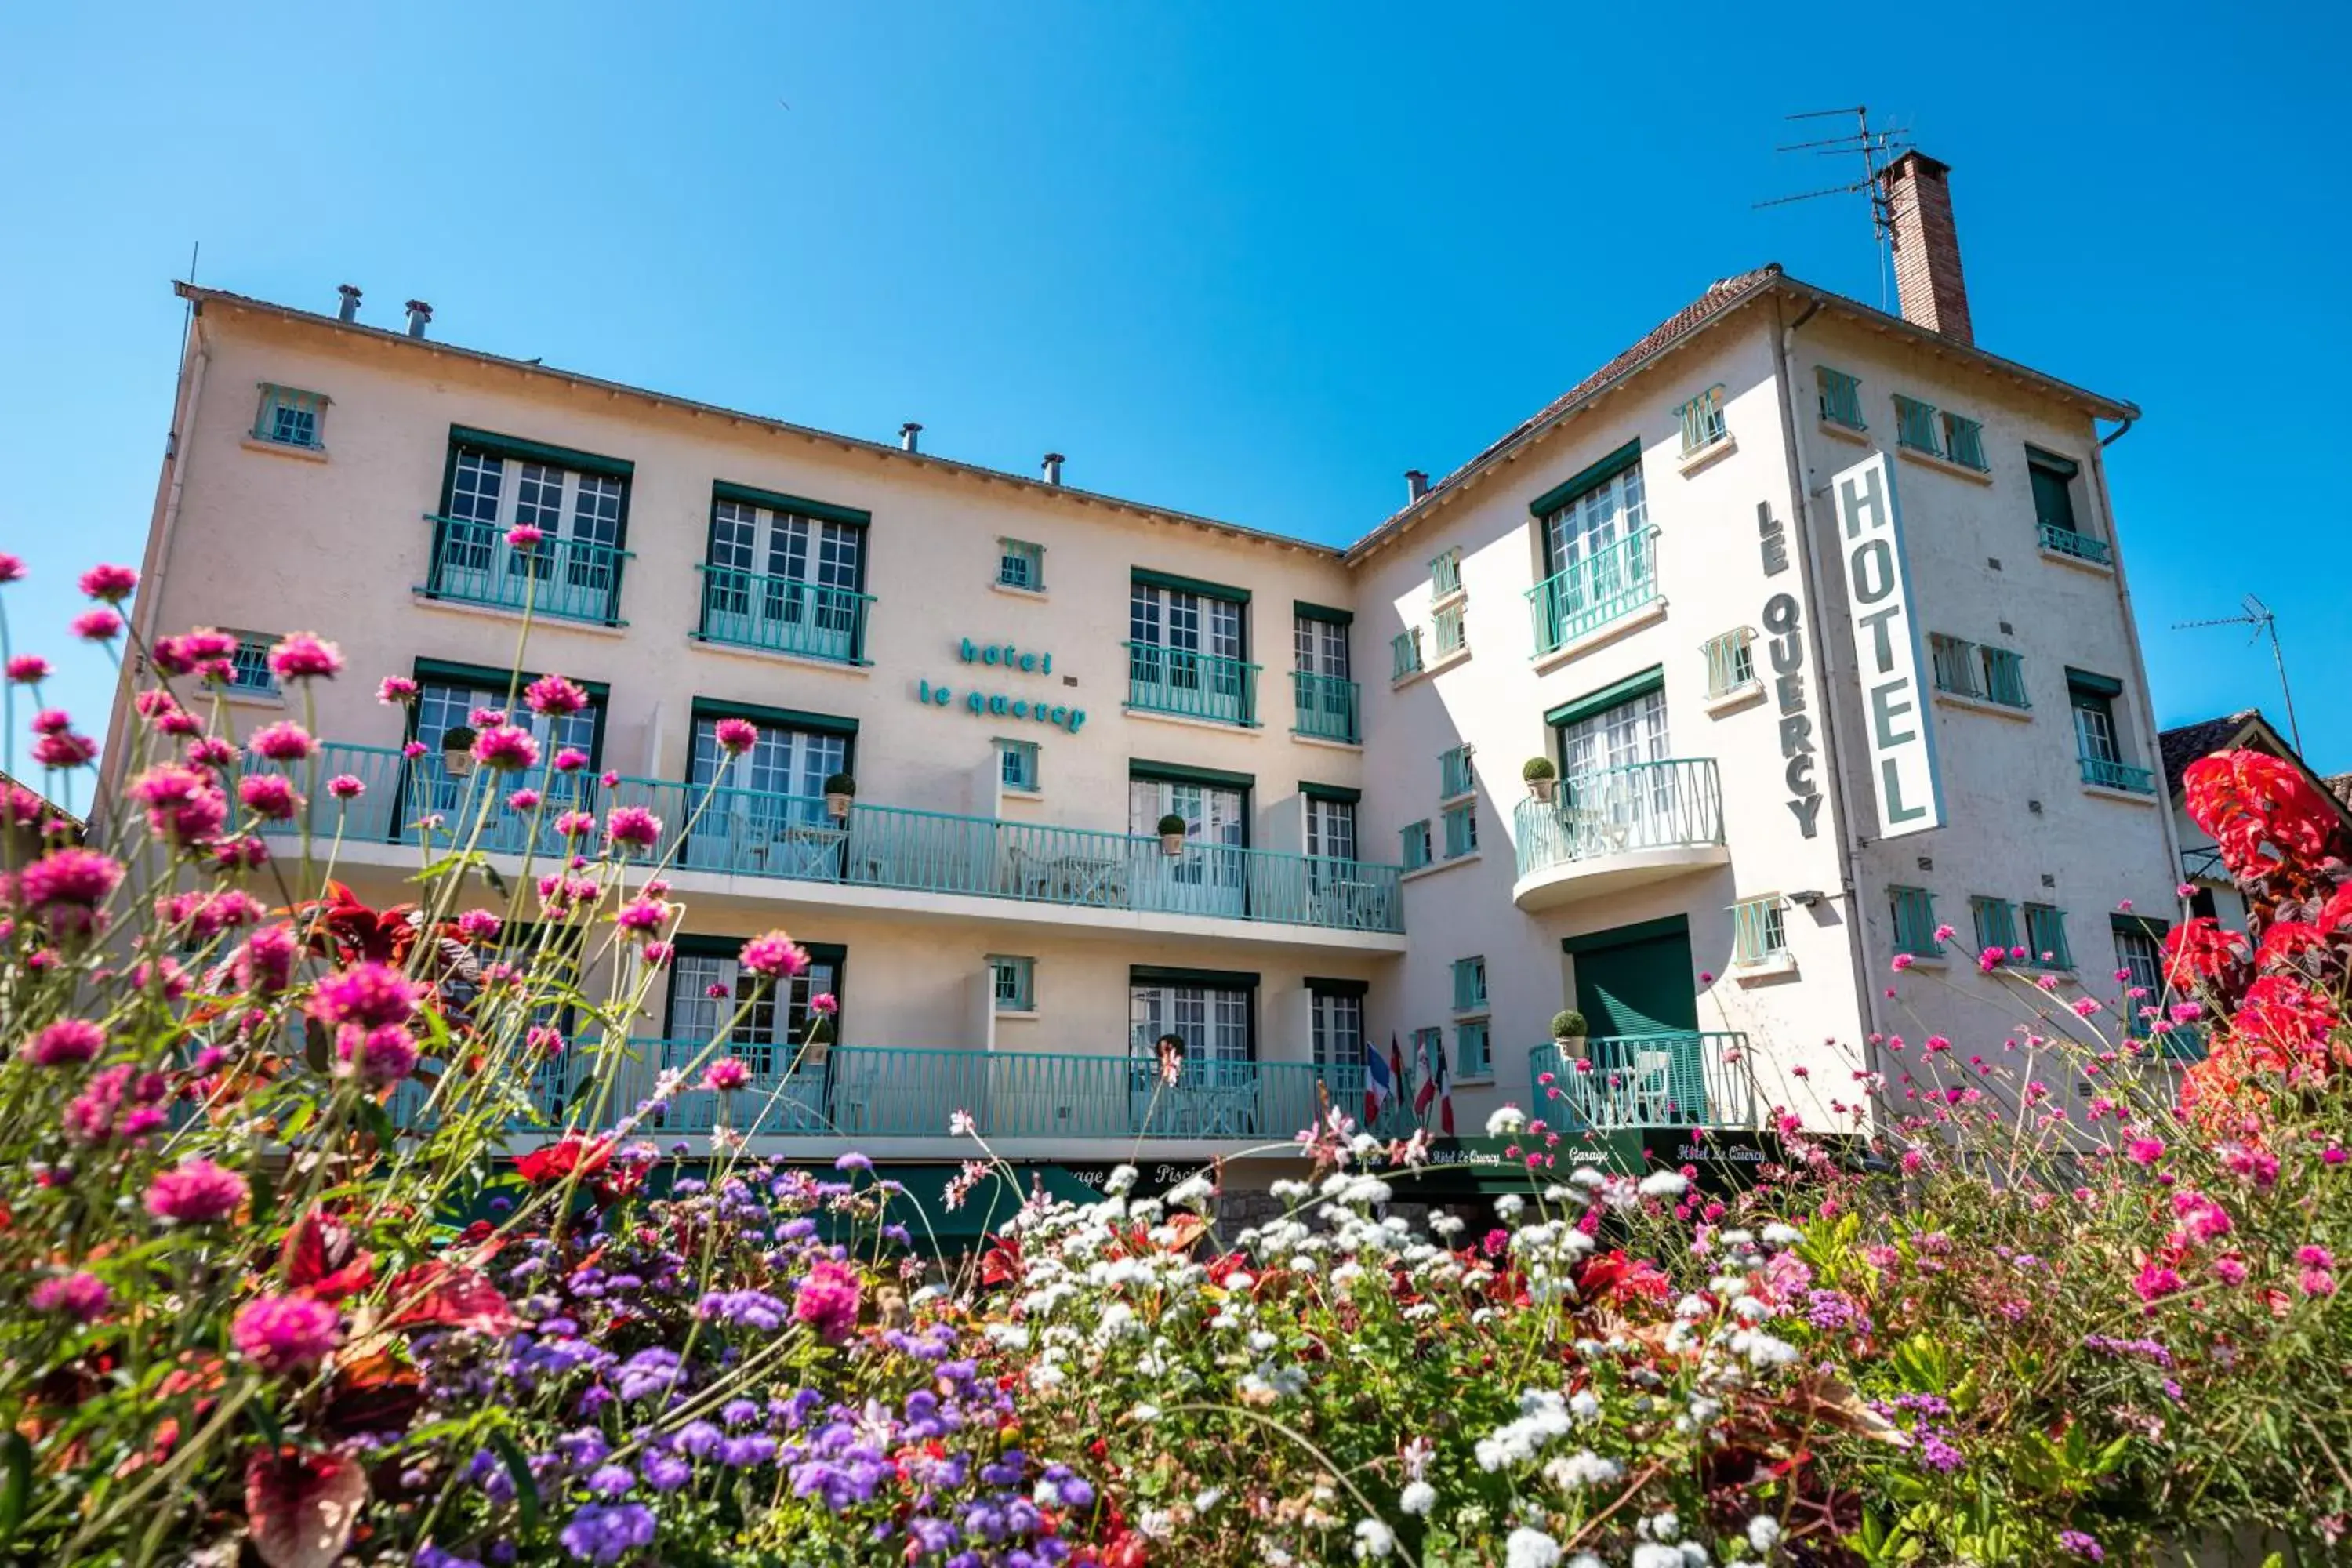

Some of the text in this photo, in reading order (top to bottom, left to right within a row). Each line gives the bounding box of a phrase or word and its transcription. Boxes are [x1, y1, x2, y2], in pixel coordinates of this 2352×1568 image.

[1757, 500, 1824, 840] LE QUERCY
[1841, 467, 1926, 825] HOTEL
[1569, 1146, 1610, 1166] Garage
